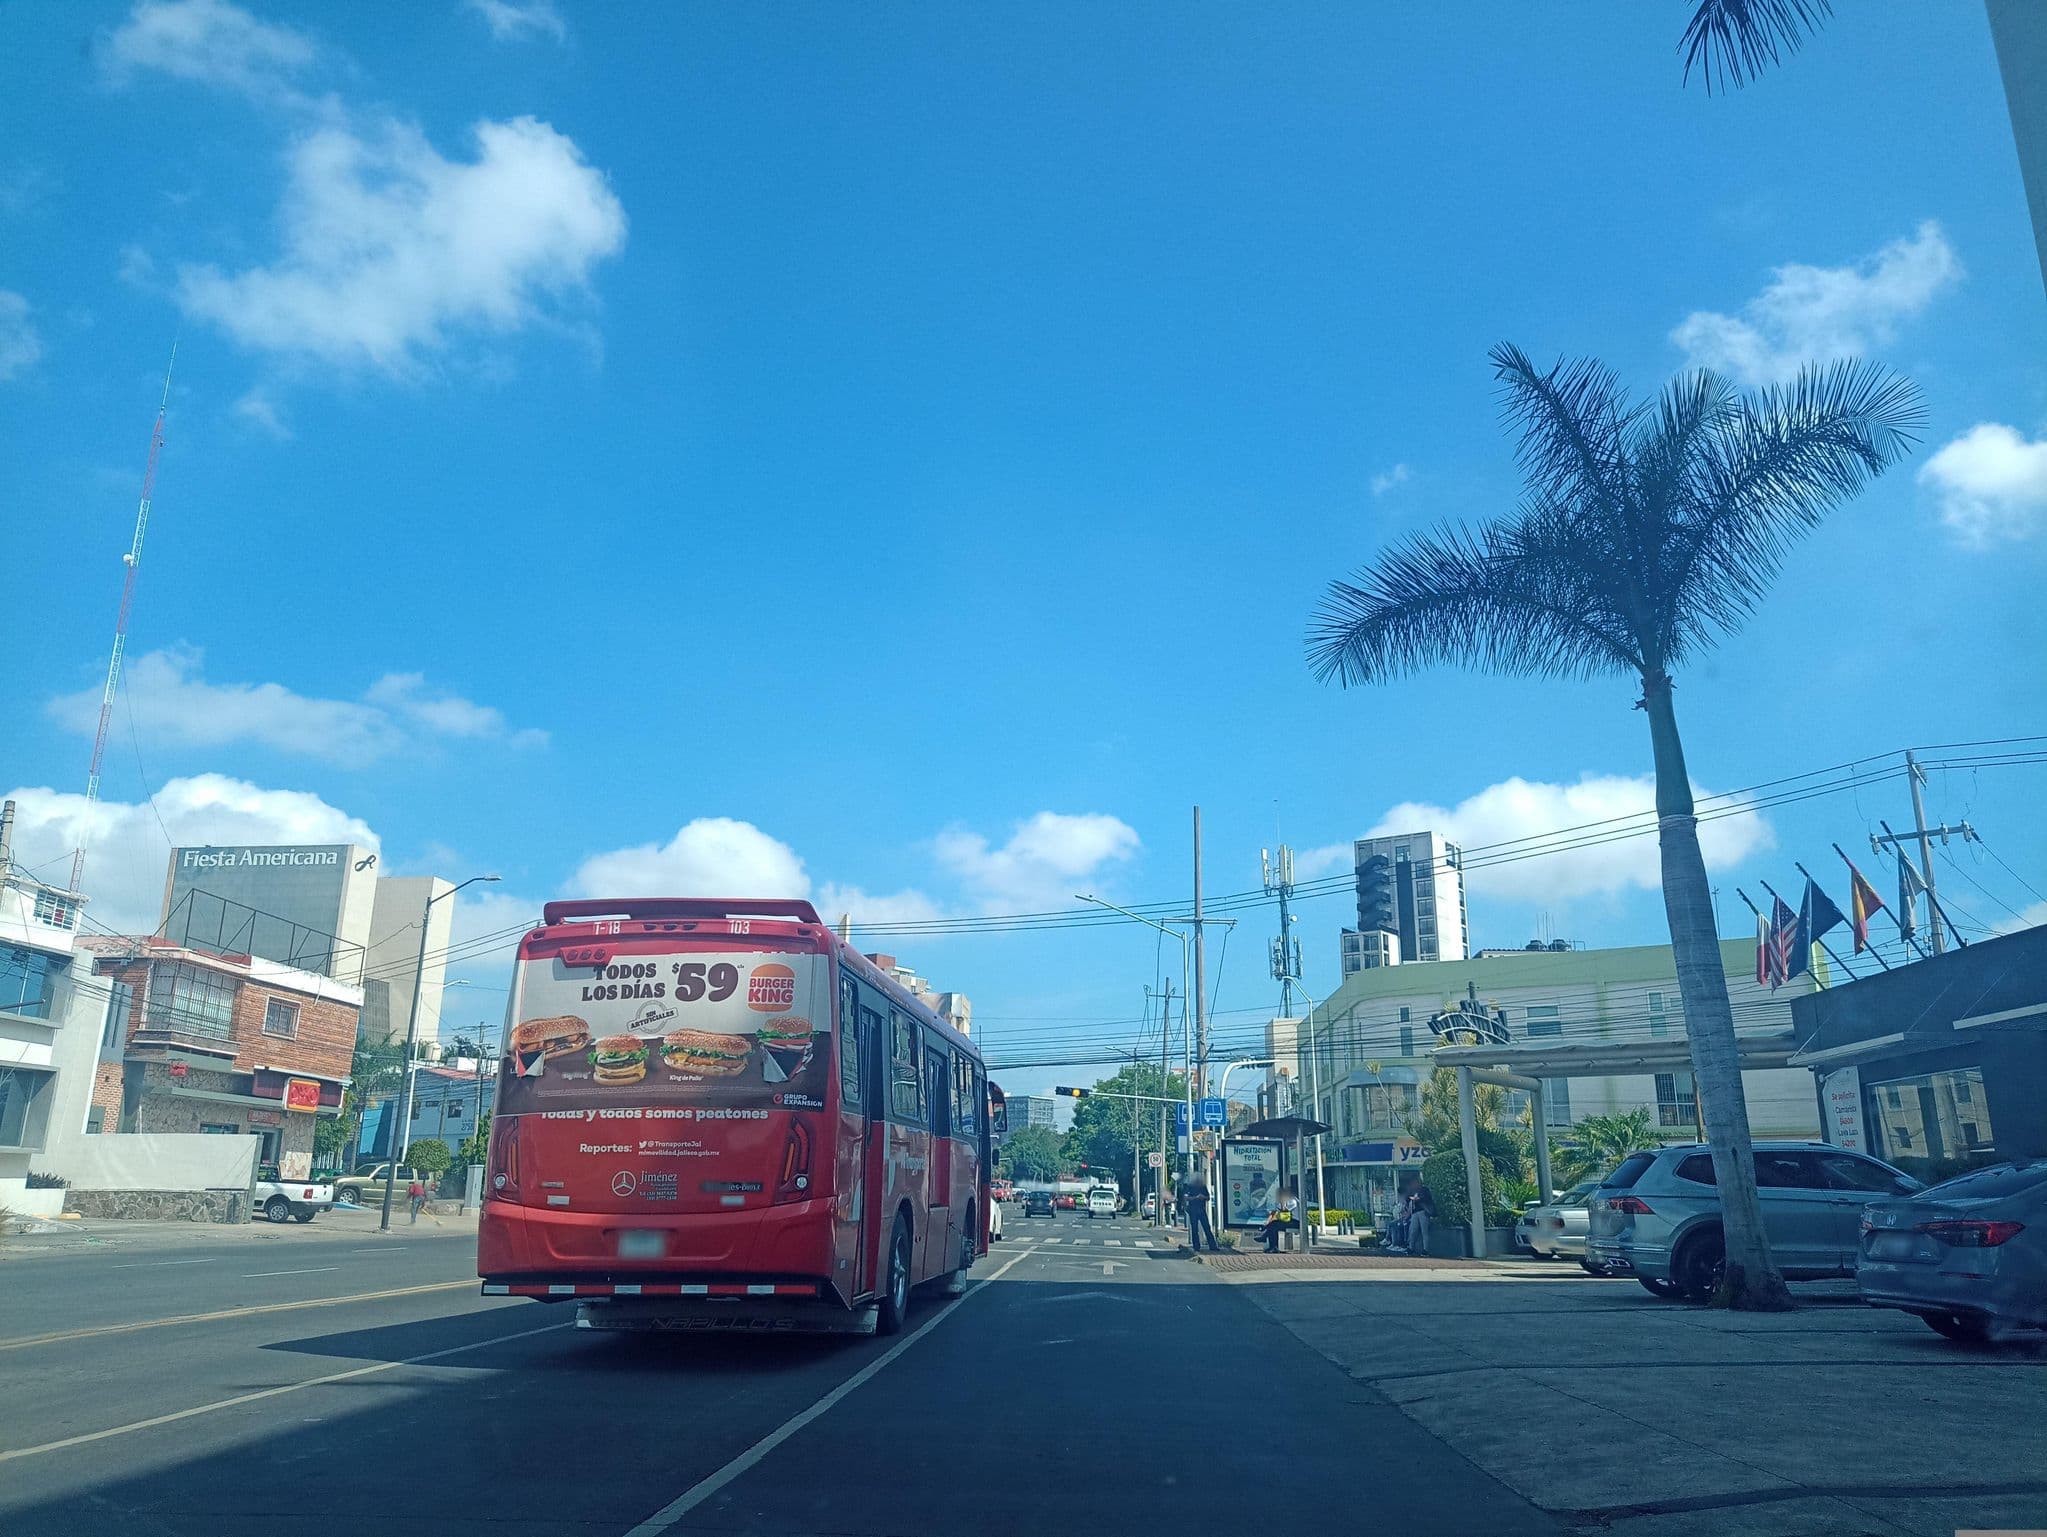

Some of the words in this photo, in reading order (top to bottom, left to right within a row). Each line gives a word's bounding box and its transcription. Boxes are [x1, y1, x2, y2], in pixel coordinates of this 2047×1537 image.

[184, 851, 236, 867] Fiesta
[239, 849, 337, 866] Americana
[594, 922, 620, 935] T-18
[729, 920, 750, 935] 103
[593, 963, 657, 980] TODOS
[582, 983, 617, 1001] LOS
[620, 979, 666, 999] DÍAS
[749, 978, 795, 989] BURGER
[748, 988, 794, 1003] KING
[631, 1010, 675, 1029] ARTIFICIALES
[585, 1109, 598, 1122] y
[599, 1109, 643, 1119] todos
[645, 1109, 692, 1119] somos
[696, 1108, 769, 1121] peatones
[579, 1143, 633, 1155] Reportes:
[640, 1171, 678, 1184] Jiménez
